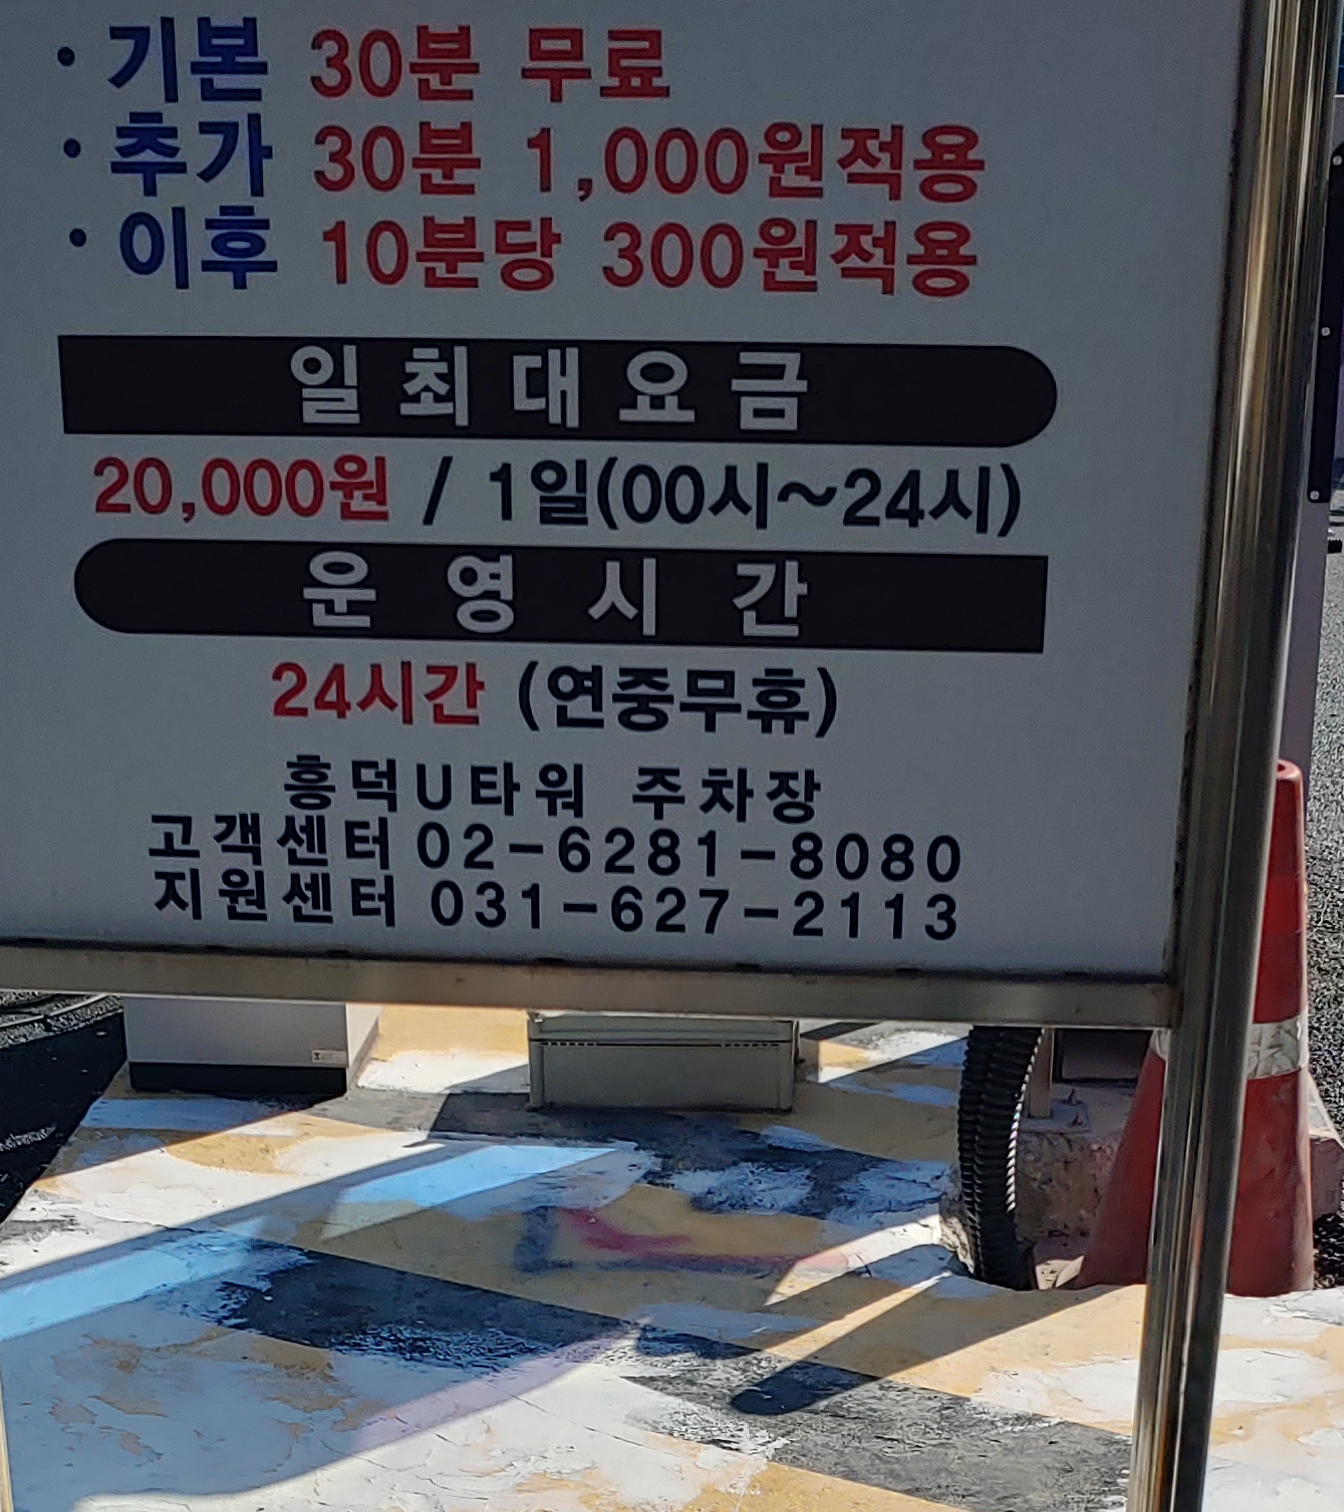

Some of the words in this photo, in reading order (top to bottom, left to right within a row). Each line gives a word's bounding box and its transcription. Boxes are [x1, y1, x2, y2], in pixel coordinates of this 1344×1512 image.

[108, 16, 268, 102] 기본
[310, 25, 480, 100] 30분
[521, 26, 670, 103] 무료
[110, 111, 273, 199] 추가
[314, 121, 481, 196] 30분
[527, 121, 985, 203] 1,000원적용
[119, 205, 278, 290] 이후
[323, 216, 562, 291] 10분당
[602, 217, 977, 298] 300원적용
[93, 454, 390, 523] 20,000원
[422, 456, 454, 525] /
[271, 661, 486, 726] 24시간
[518, 661, 838, 739] (연중무휴)
[283, 754, 583, 818] 흥덕U타워
[632, 766, 821, 824] 주차장
[148, 812, 390, 871] 고객센터
[416, 821, 961, 882] 02-6281-8080
[154, 868, 396, 928] 지원센터
[430, 879, 958, 941] 031-627-2113
